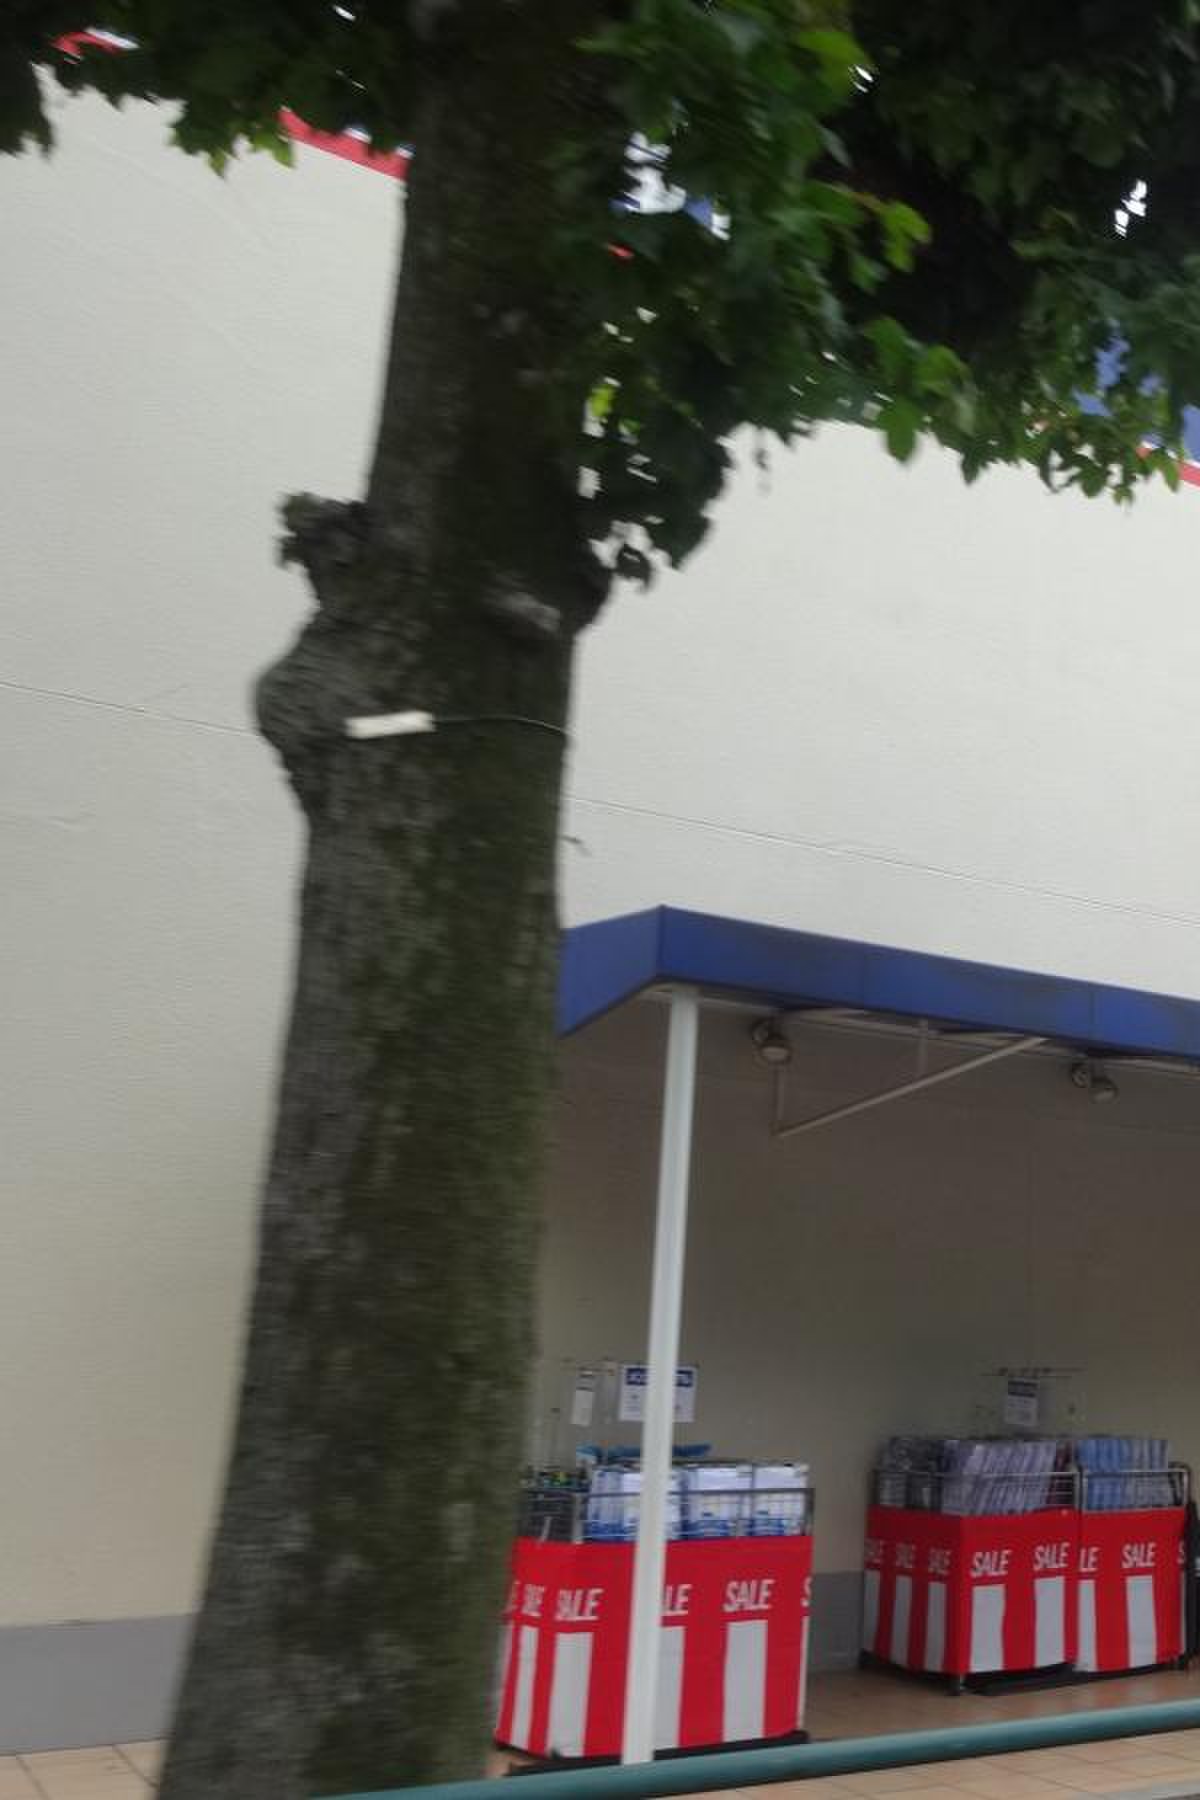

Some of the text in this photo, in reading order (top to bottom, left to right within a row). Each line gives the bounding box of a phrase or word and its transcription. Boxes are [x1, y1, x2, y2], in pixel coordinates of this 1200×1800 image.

[969, 1541, 1070, 1578] SALE SALE
[1079, 1546, 1100, 1572] LE
[1121, 1541, 1157, 1570] SALE
[659, 1583, 693, 1616] LE
[721, 1577, 775, 1613] SALE
